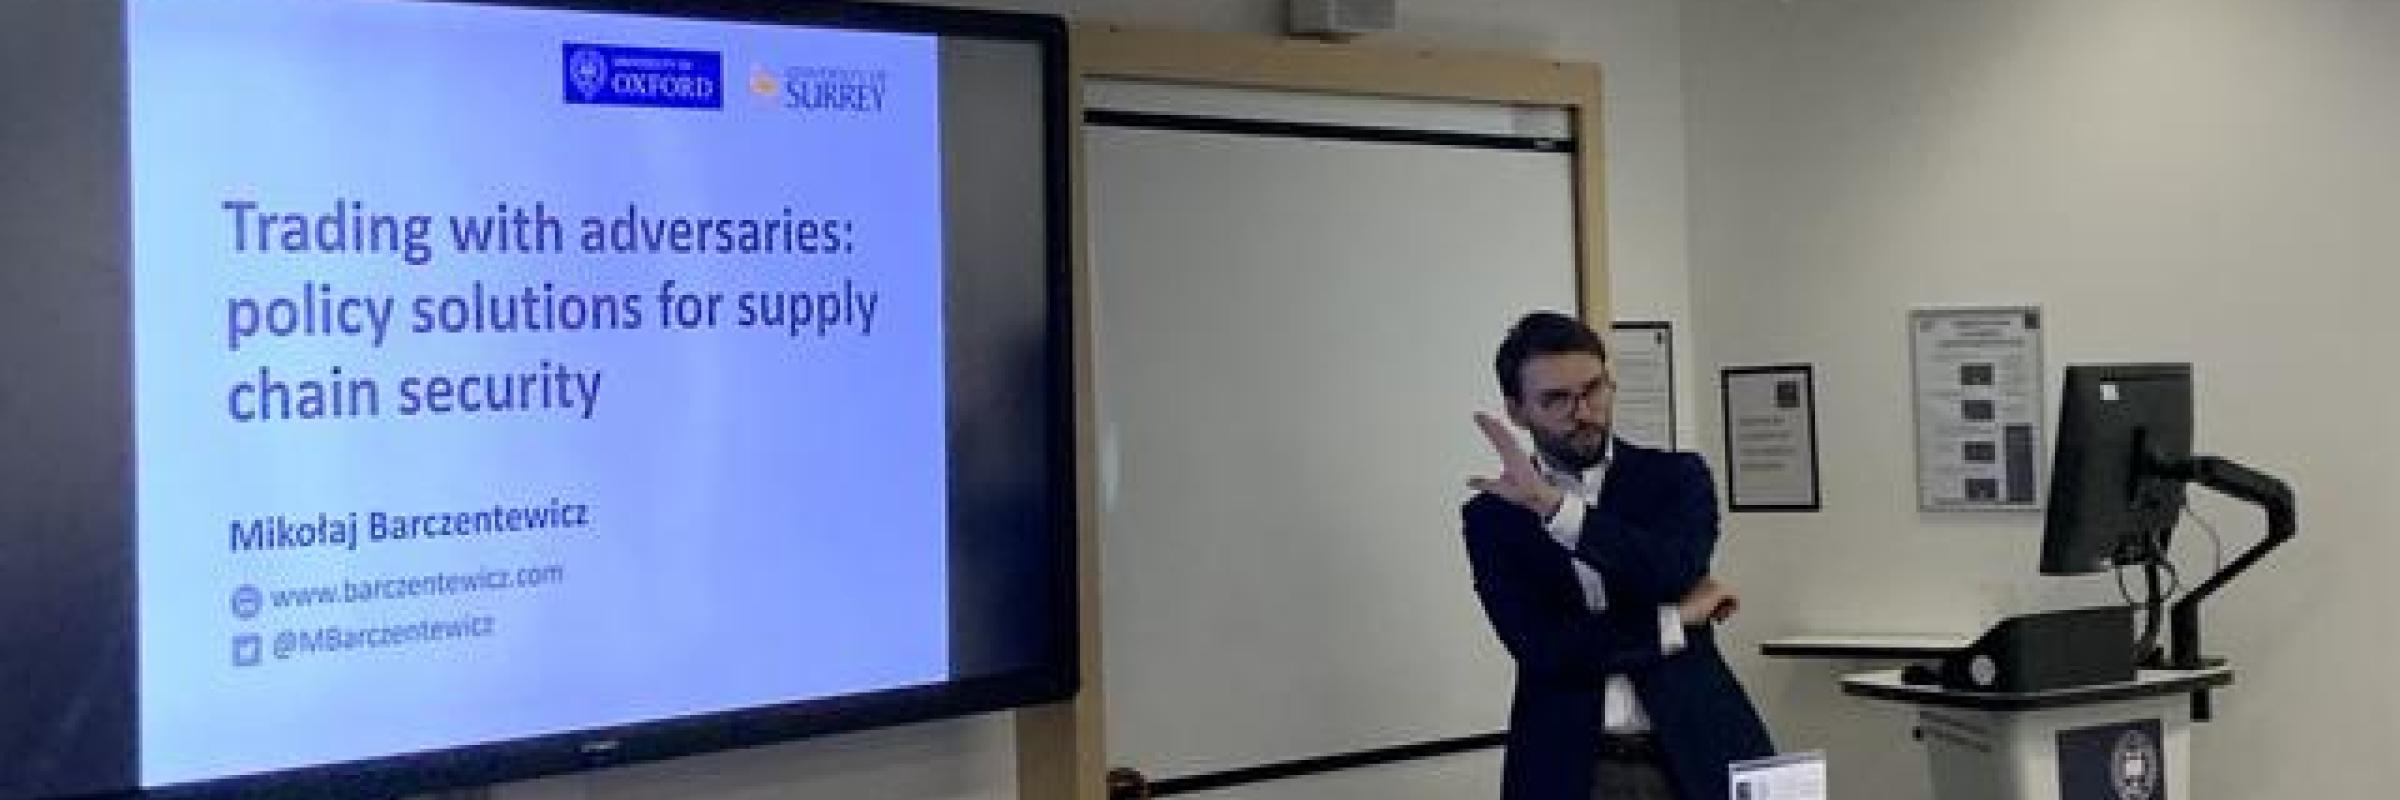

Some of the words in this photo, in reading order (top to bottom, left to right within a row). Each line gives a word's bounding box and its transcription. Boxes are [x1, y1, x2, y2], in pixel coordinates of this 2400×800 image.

[222, 198, 432, 266] Trading
[449, 200, 564, 256] with
[580, 201, 854, 256] adversaries:
[226, 280, 395, 352] policy
[412, 280, 642, 334] solutions
[657, 279, 725, 330] for
[738, 280, 879, 337] supply
[227, 365, 380, 422] chain
[398, 358, 602, 420] security
[230, 511, 358, 552] Mikołaj
[369, 497, 590, 542] Barczentewicz
[270, 563, 564, 607] www.barczentewicz.com
[273, 614, 496, 660] @MBarczentewicz
